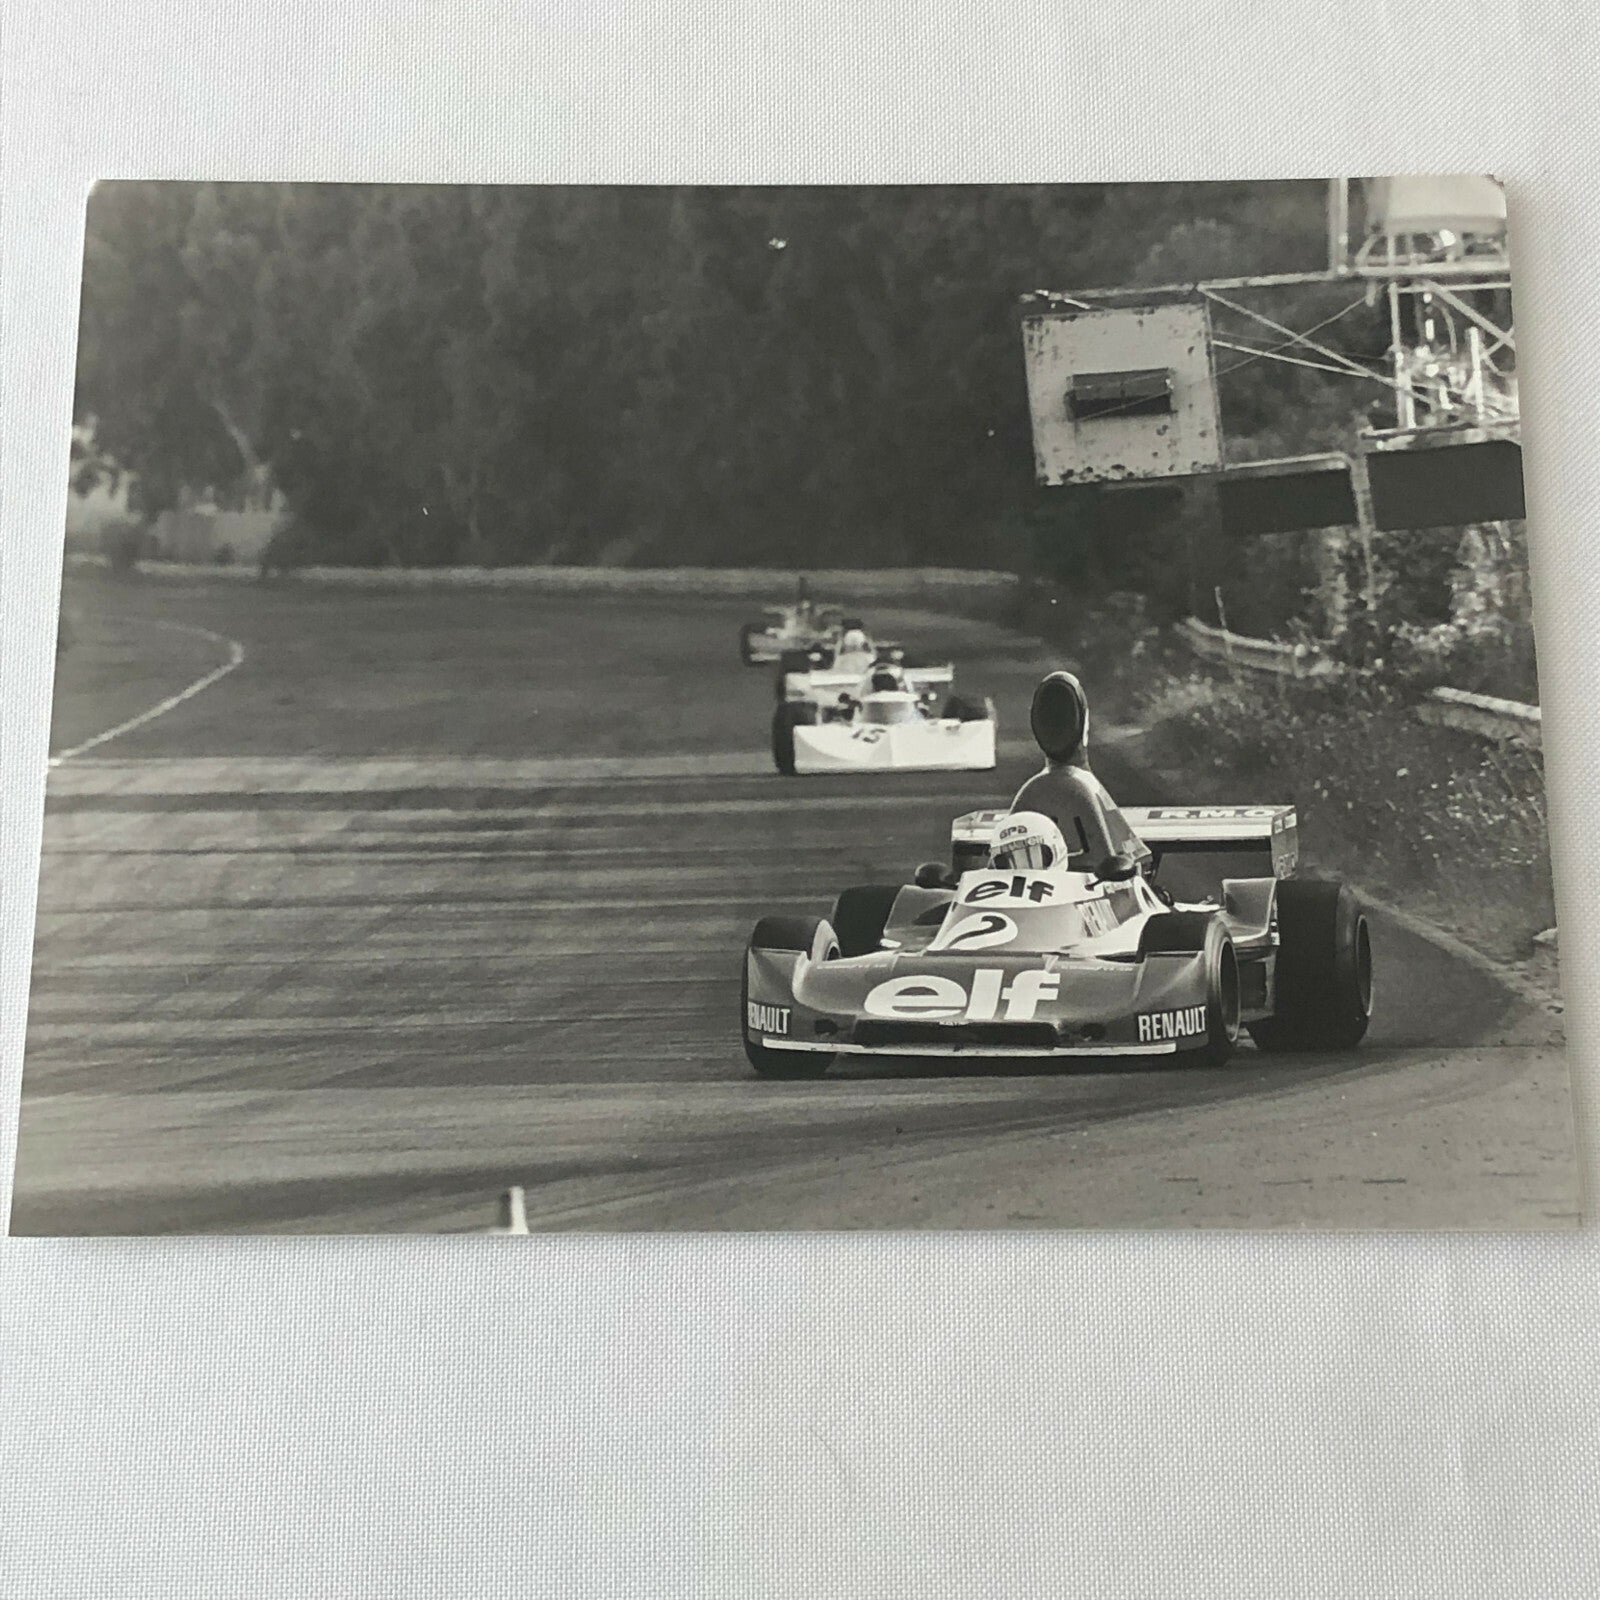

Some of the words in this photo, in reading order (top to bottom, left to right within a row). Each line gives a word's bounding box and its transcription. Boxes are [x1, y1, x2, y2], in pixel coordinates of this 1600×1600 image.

[964, 875, 1054, 903] elf
[949, 915, 1007, 948] 2
[864, 968, 1061, 1020] elf
[1138, 1005, 1207, 1042] RENAULT
